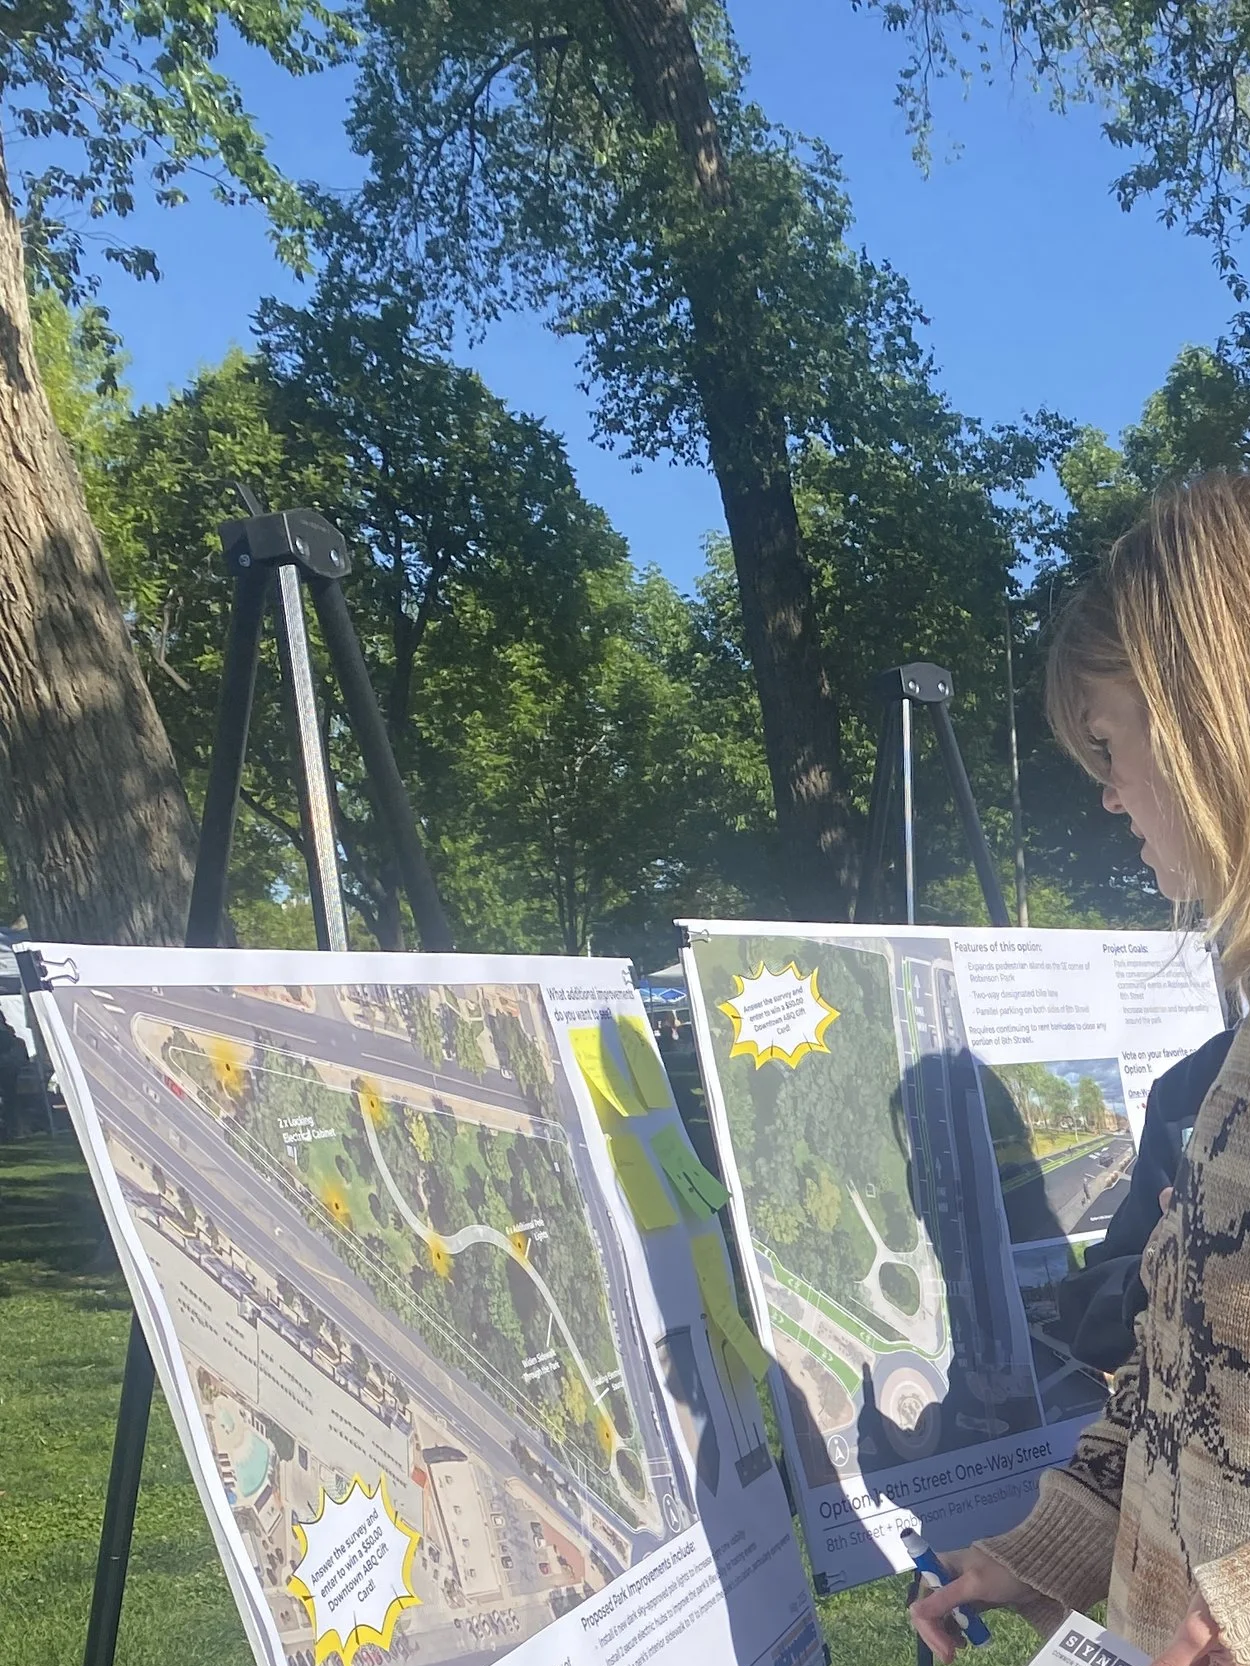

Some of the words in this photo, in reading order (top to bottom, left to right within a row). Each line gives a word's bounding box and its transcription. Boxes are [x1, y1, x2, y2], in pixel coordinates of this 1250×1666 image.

[954, 942, 988, 952] Features
[989, 941, 998, 952] of
[1000, 941, 1016, 952] this
[1017, 942, 1042, 953] option:
[1102, 944, 1127, 956] Project
[1128, 944, 1148, 953] Goals:
[744, 1001, 762, 1013] Answer
[762, 998, 773, 1006] the
[773, 991, 792, 1003] survey
[792, 986, 803, 995] and
[754, 1016, 783, 1032] Downtown
[783, 1012, 796, 1023] ABQ
[795, 1008, 806, 1018] Gift
[1121, 1051, 1136, 1060] Vote
[1138, 1052, 1146, 1060] on
[1147, 1051, 1162, 1062] your
[1163, 1048, 1188, 1058] favorite
[819, 1493, 872, 1520] Option
[886, 1481, 910, 1502] 8th
[913, 1470, 953, 1494] Street
[955, 1453, 1015, 1482] One-Way
[1016, 1442, 1052, 1464] Street
[311, 1555, 335, 1586] Answer
[334, 1543, 346, 1560] the
[345, 1524, 367, 1551] survey
[366, 1508, 379, 1527] and
[321, 1574, 339, 1598] enter
[337, 1568, 346, 1579] to
[345, 1554, 359, 1572] win
[358, 1549, 364, 1558] a
[363, 1526, 383, 1553] $50.00
[328, 1572, 364, 1612] Downtown
[364, 1554, 380, 1575] ABQ
[378, 1543, 389, 1559] Gift
[581, 1597, 614, 1631] Proposed
[613, 1587, 628, 1607] Park
[627, 1558, 672, 1598] Improvements
[672, 1541, 695, 1564] include:
[357, 1579, 376, 1603] Card!
[1052, 1649, 1074, 1666] COMMON
